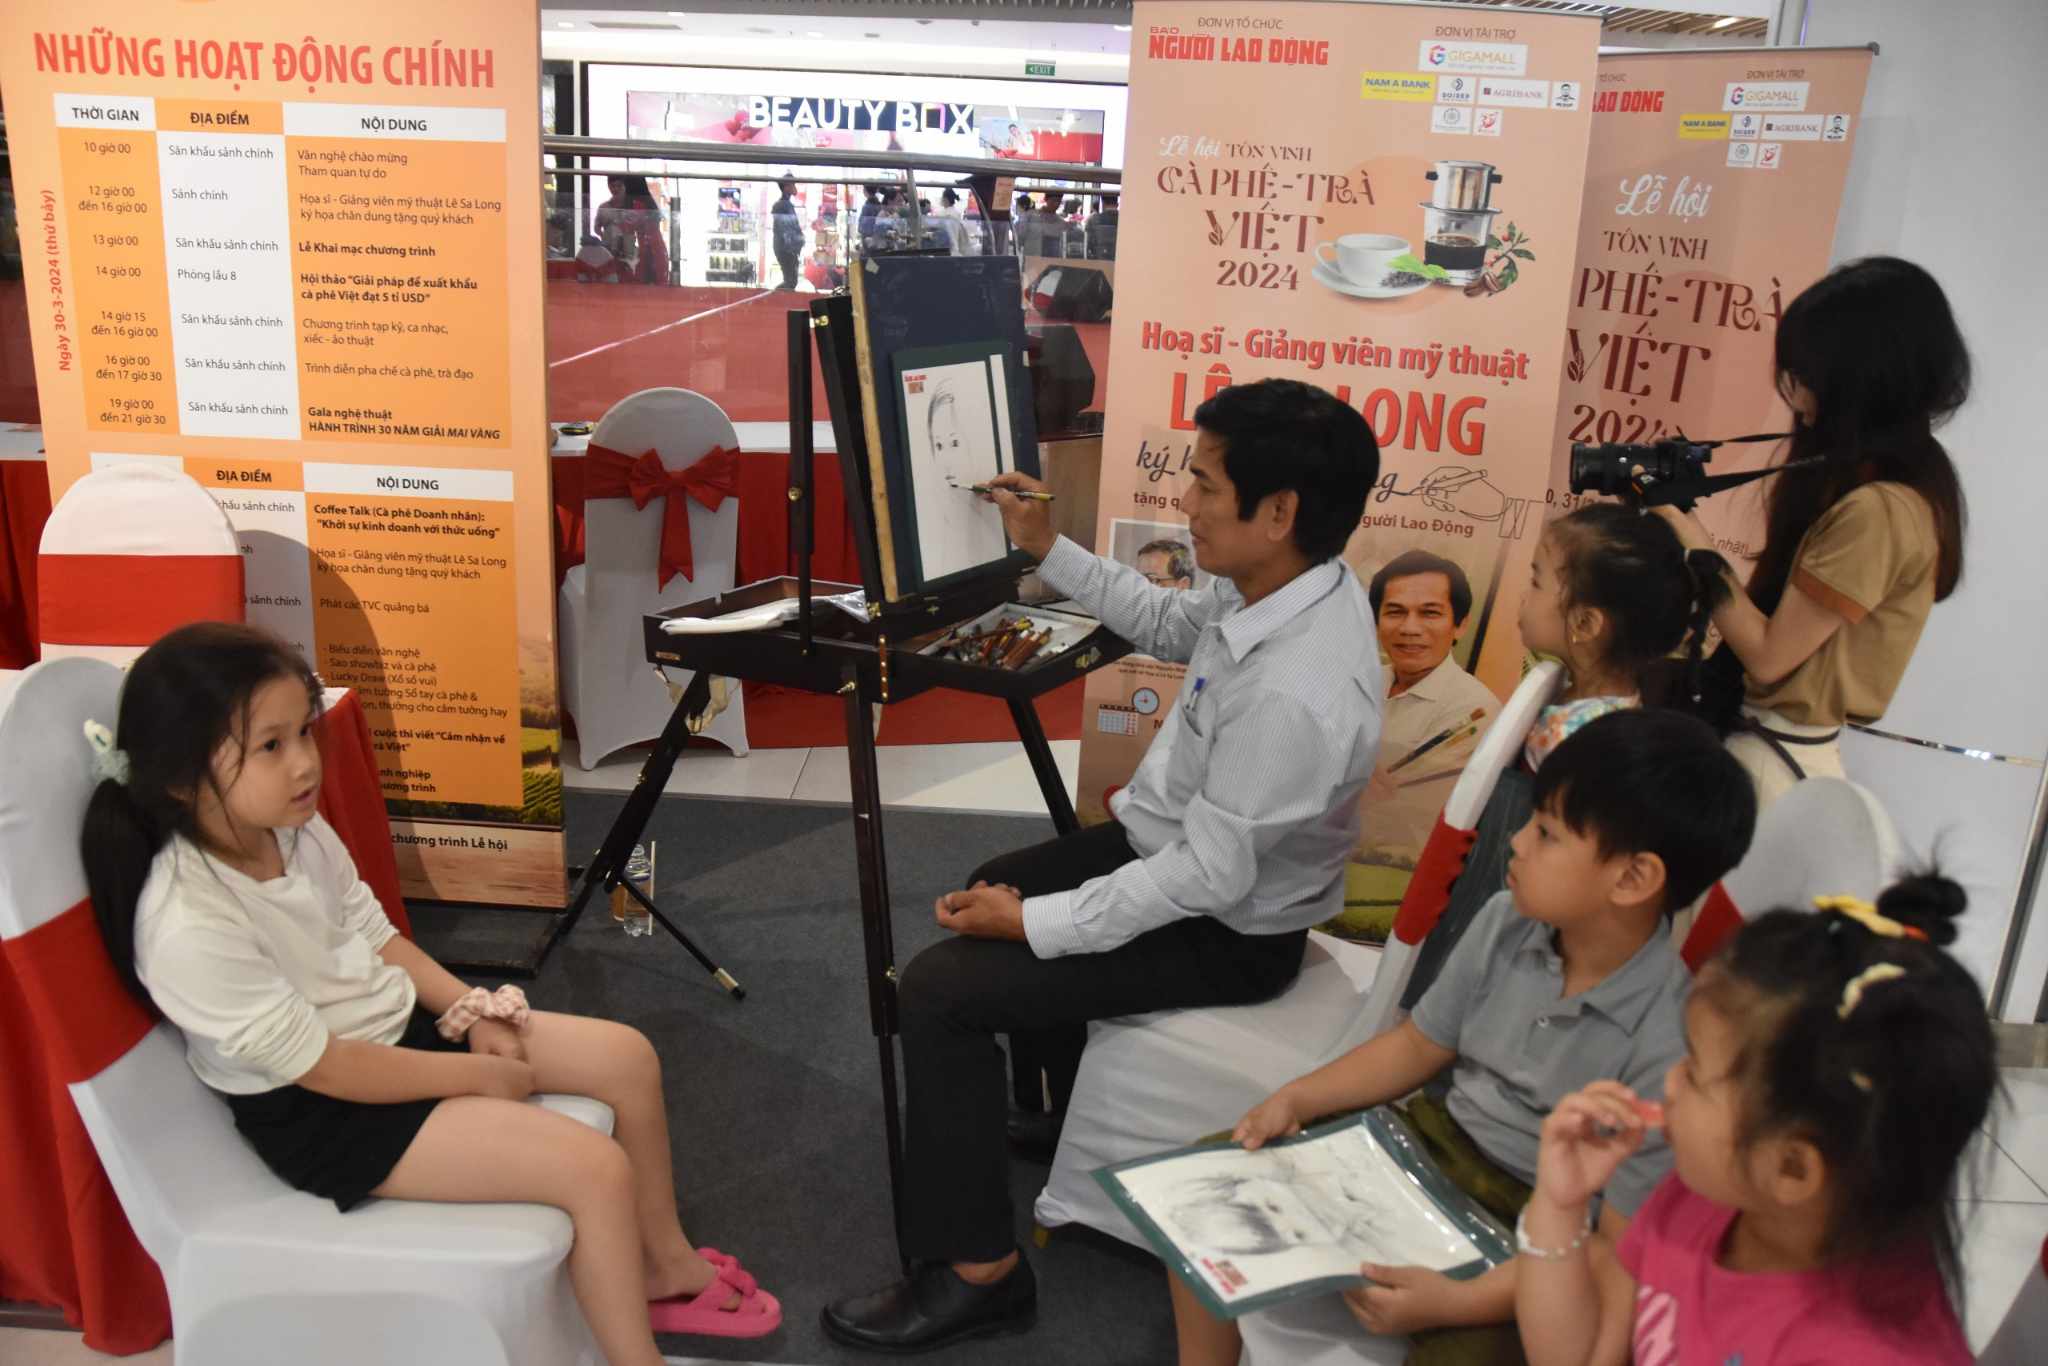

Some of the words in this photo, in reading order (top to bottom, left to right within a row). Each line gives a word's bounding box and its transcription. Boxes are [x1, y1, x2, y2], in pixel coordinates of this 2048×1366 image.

[1197, 16, 1222, 27] ĐƠN
[1435, 26, 1461, 36] ĐƠN
[1148, 31, 1215, 60] NGƯỜI
[1220, 37, 1262, 62] LAO
[1268, 38, 1328, 65] ĐỘNG
[33, 27, 165, 77] NHỮNG
[174, 39, 264, 88] HOẠT
[272, 35, 373, 90] ĐỘNG
[382, 39, 493, 87] CHÍNH
[1448, 50, 1516, 64] GIGAMALL
[1034, 64, 1054, 74] EXIT
[1365, 78, 1390, 86] NAM
[1401, 79, 1430, 88] BANK
[1493, 89, 1542, 99] AGRIBANK
[1620, 89, 1664, 114] ĐỘNG
[1745, 90, 1800, 101] GIGAMALL
[71, 106, 103, 119] THỜI
[106, 108, 139, 120] GIAN
[190, 112, 213, 124] ĐỊA
[216, 111, 249, 125] ĐIỂM
[748, 96, 886, 132] BEAUTY
[897, 101, 974, 134] BOX
[361, 116, 384, 132] NỘI
[388, 118, 427, 131] DUNG
[84, 141, 96, 152] 10
[117, 143, 131, 153] 00
[1160, 135, 1189, 156] Lễ
[1226, 142, 1264, 158] TÔN
[1270, 146, 1312, 162] VINH
[1157, 161, 1203, 195] CÀ
[1615, 174, 1667, 216] Lễ
[1668, 176, 1712, 222] hội
[1205, 202, 1324, 257] VIỆT
[298, 240, 311, 252] Lễ
[313, 242, 338, 252] Khai
[340, 245, 362, 256] mạc
[364, 244, 406, 258] chương
[408, 245, 435, 256] trình
[1603, 229, 1651, 254] TÔN
[1658, 234, 1709, 260] VINH
[177, 268, 210, 282] Phòng
[230, 270, 236, 280] 8
[300, 273, 319, 285] Hội
[423, 277, 447, 288] xuất
[1217, 261, 1300, 290] 2024
[48, 259, 66, 332] 30-3-2024
[337, 290, 360, 301] Việt
[382, 292, 388, 302] 5
[56, 335, 72, 371] Ngày
[1200, 326, 1222, 355] sĩ
[1245, 328, 1325, 369] Giảng
[1332, 334, 1392, 368] viên
[1399, 342, 1443, 379] mỹ
[1448, 344, 1530, 386] thuật
[357, 364, 377, 376] pha
[1567, 321, 1710, 406] VIỆT
[307, 406, 331, 416] Gala
[334, 407, 361, 420] nghệ
[363, 409, 392, 421] thuật
[1337, 385, 1487, 456] ONG
[308, 420, 340, 432] HÀNH
[342, 422, 376, 433] TRÌNH
[378, 424, 391, 434] 30
[422, 424, 444, 436] GIẢI
[447, 427, 468, 437] MAI
[470, 427, 500, 439] VÀNG
[1136, 440, 1176, 482] ký
[216, 470, 238, 483] ĐỊA
[240, 468, 272, 482] ĐIỂM
[376, 476, 399, 490] NỘI
[402, 478, 438, 490] DUNG
[1134, 492, 1167, 509] tặng
[314, 504, 347, 514] Coffee
[348, 505, 370, 515] Talk
[413, 508, 448, 519] Doanh
[361, 520, 385, 531] kinh
[387, 522, 421, 532] doanh
[1359, 510, 1396, 528] gười
[1400, 515, 1428, 530] Lao
[1431, 519, 1474, 537] Động
[399, 729, 413, 738] thi
[438, 836, 468, 847] trình
[488, 838, 508, 852] hội
